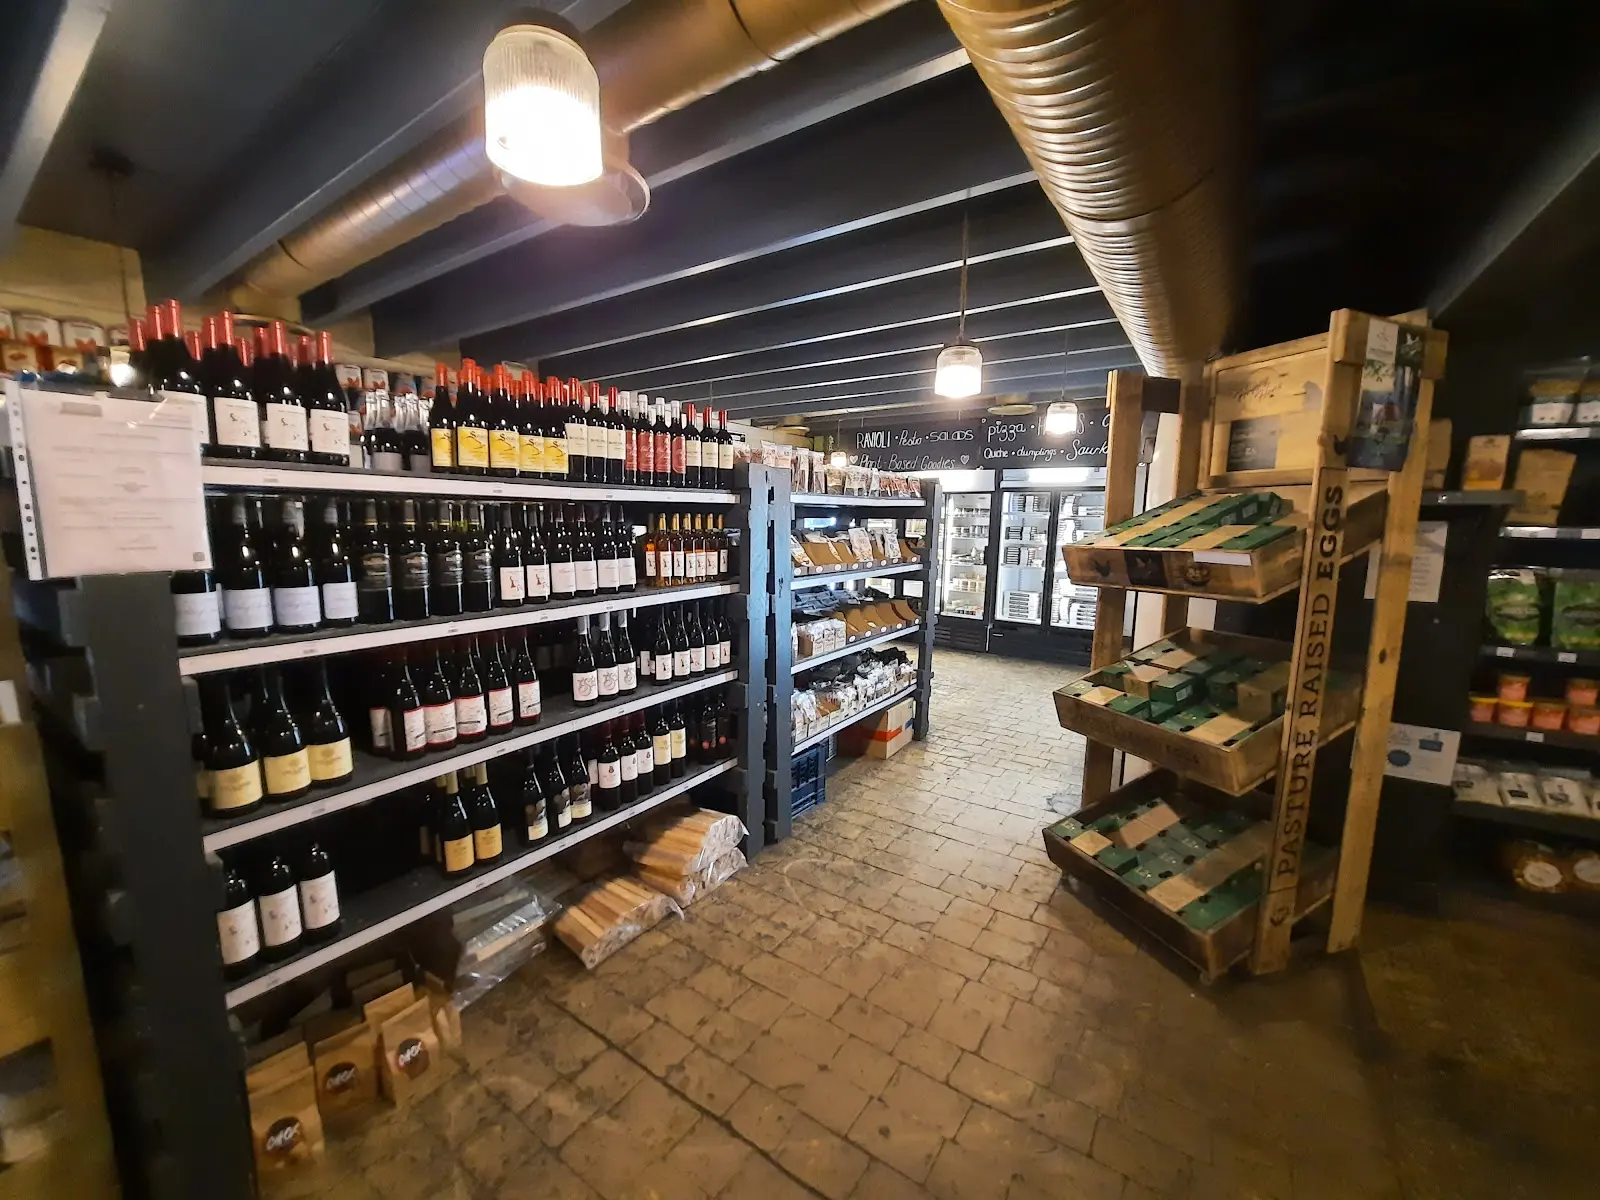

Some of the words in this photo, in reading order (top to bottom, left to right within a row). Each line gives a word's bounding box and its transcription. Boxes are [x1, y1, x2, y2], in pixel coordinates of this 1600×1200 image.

[856, 430, 891, 449] RAVIOLI
[898, 429, 922, 447] Pesto
[987, 421, 1027, 443] pizza
[920, 455, 956, 470] Goodies
[983, 446, 1009, 459] Quiche
[1016, 445, 1057, 462] dumplings
[1276, 729, 1315, 877] PASTURE
[1298, 593, 1331, 718] RAISED
[1316, 484, 1344, 581] EGGS
